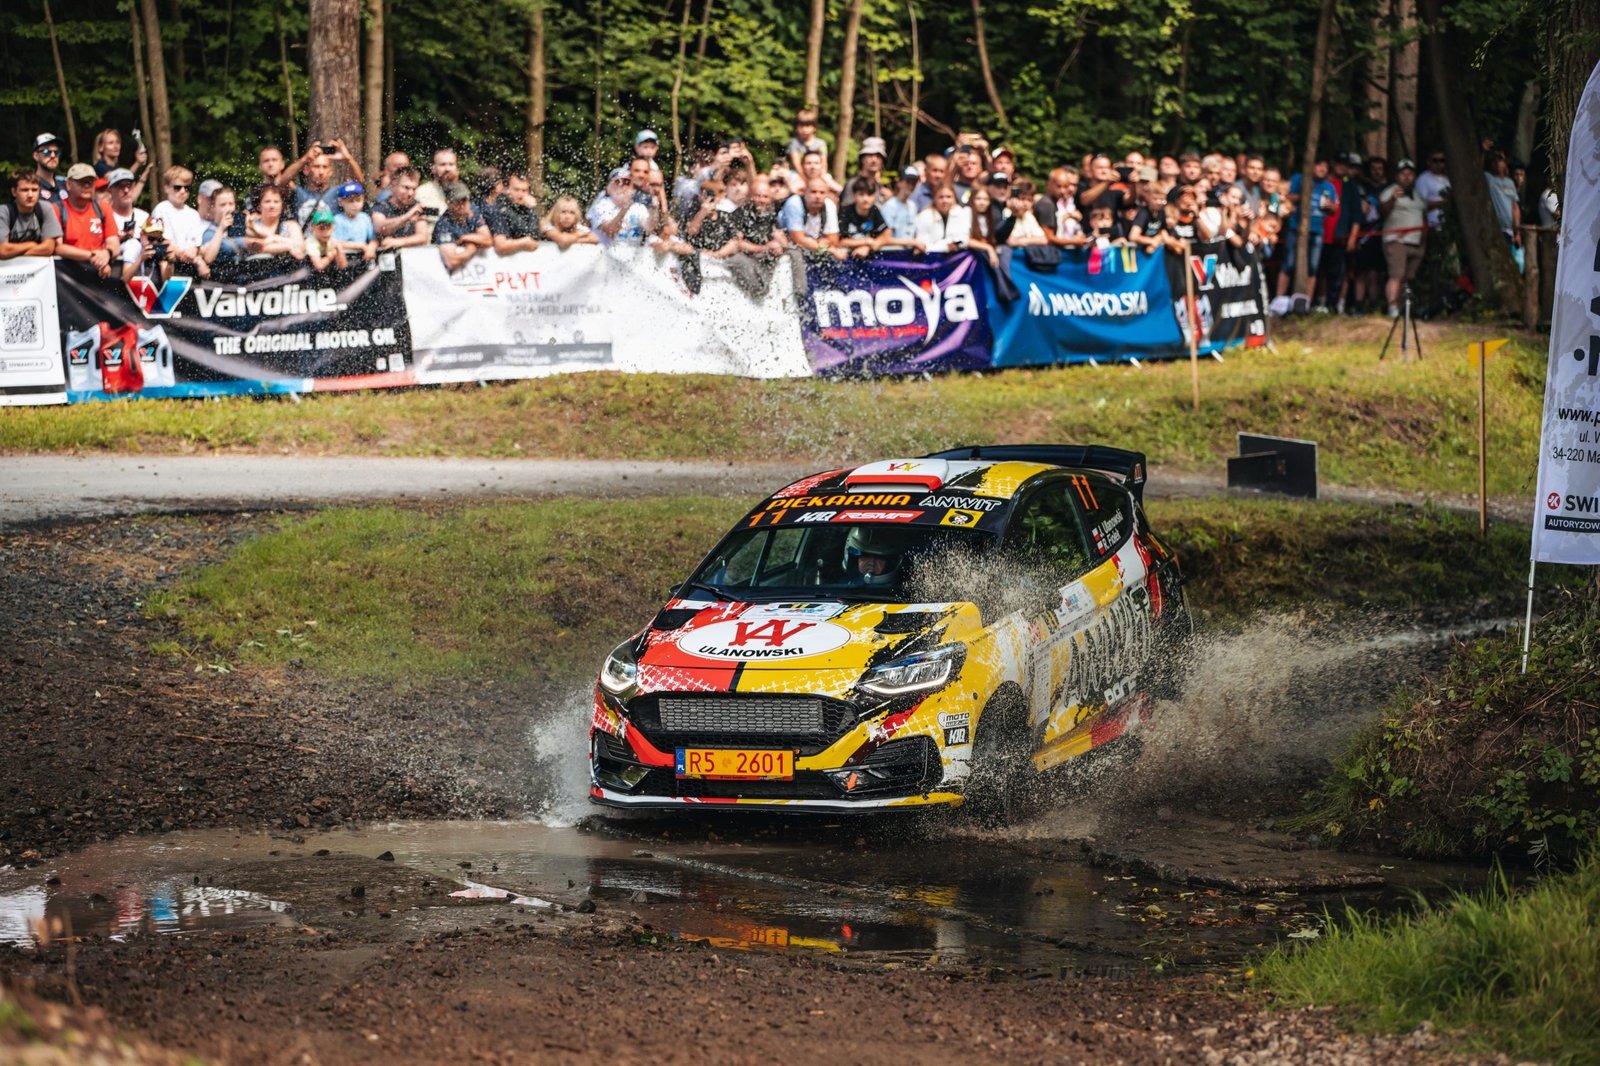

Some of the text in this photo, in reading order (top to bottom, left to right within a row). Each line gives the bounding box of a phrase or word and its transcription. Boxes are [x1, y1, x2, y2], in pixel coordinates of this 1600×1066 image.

[813, 275, 979, 346] moya
[213, 337, 241, 355] THE
[244, 332, 313, 354] ORIGINAL
[315, 329, 370, 350] MOTOR
[1579, 430, 1590, 443] ul.
[1552, 447, 1585, 462] 34-220
[1071, 474, 1099, 510] 11
[766, 494, 912, 511] PIEKARNIA
[918, 495, 1002, 512] ANWIT
[749, 509, 788, 527] 11
[839, 510, 916, 521] RSMP
[1548, 518, 1600, 530] AUTORYZOW
[698, 645, 804, 658] ULANOWSKI
[689, 752, 784, 774] R5 2601
